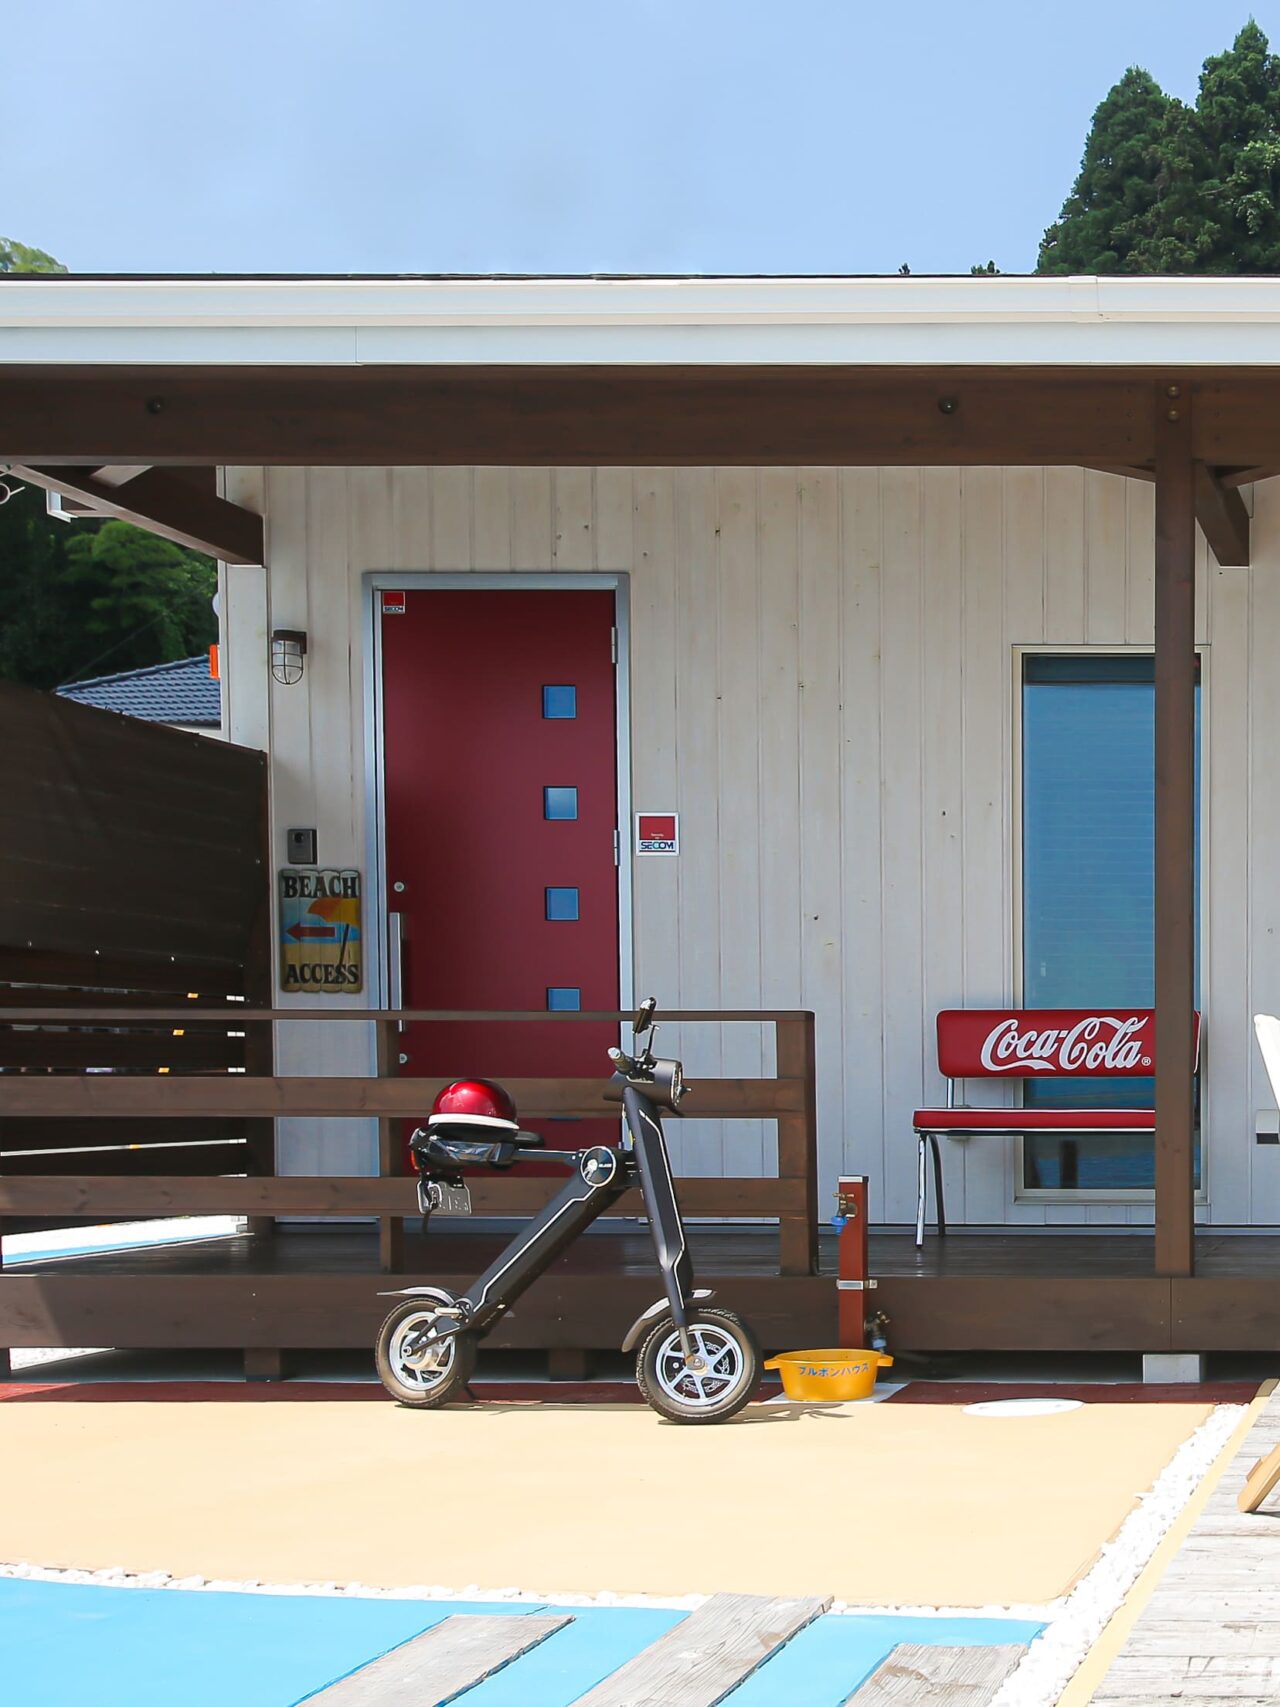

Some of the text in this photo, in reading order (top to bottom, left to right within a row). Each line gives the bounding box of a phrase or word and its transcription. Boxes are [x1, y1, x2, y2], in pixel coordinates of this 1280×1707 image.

[641, 841, 674, 850] SECOM
[283, 875, 357, 898] BEACH
[286, 963, 359, 985] ACCESS
[980, 1016, 1149, 1071] Coca-Cola
